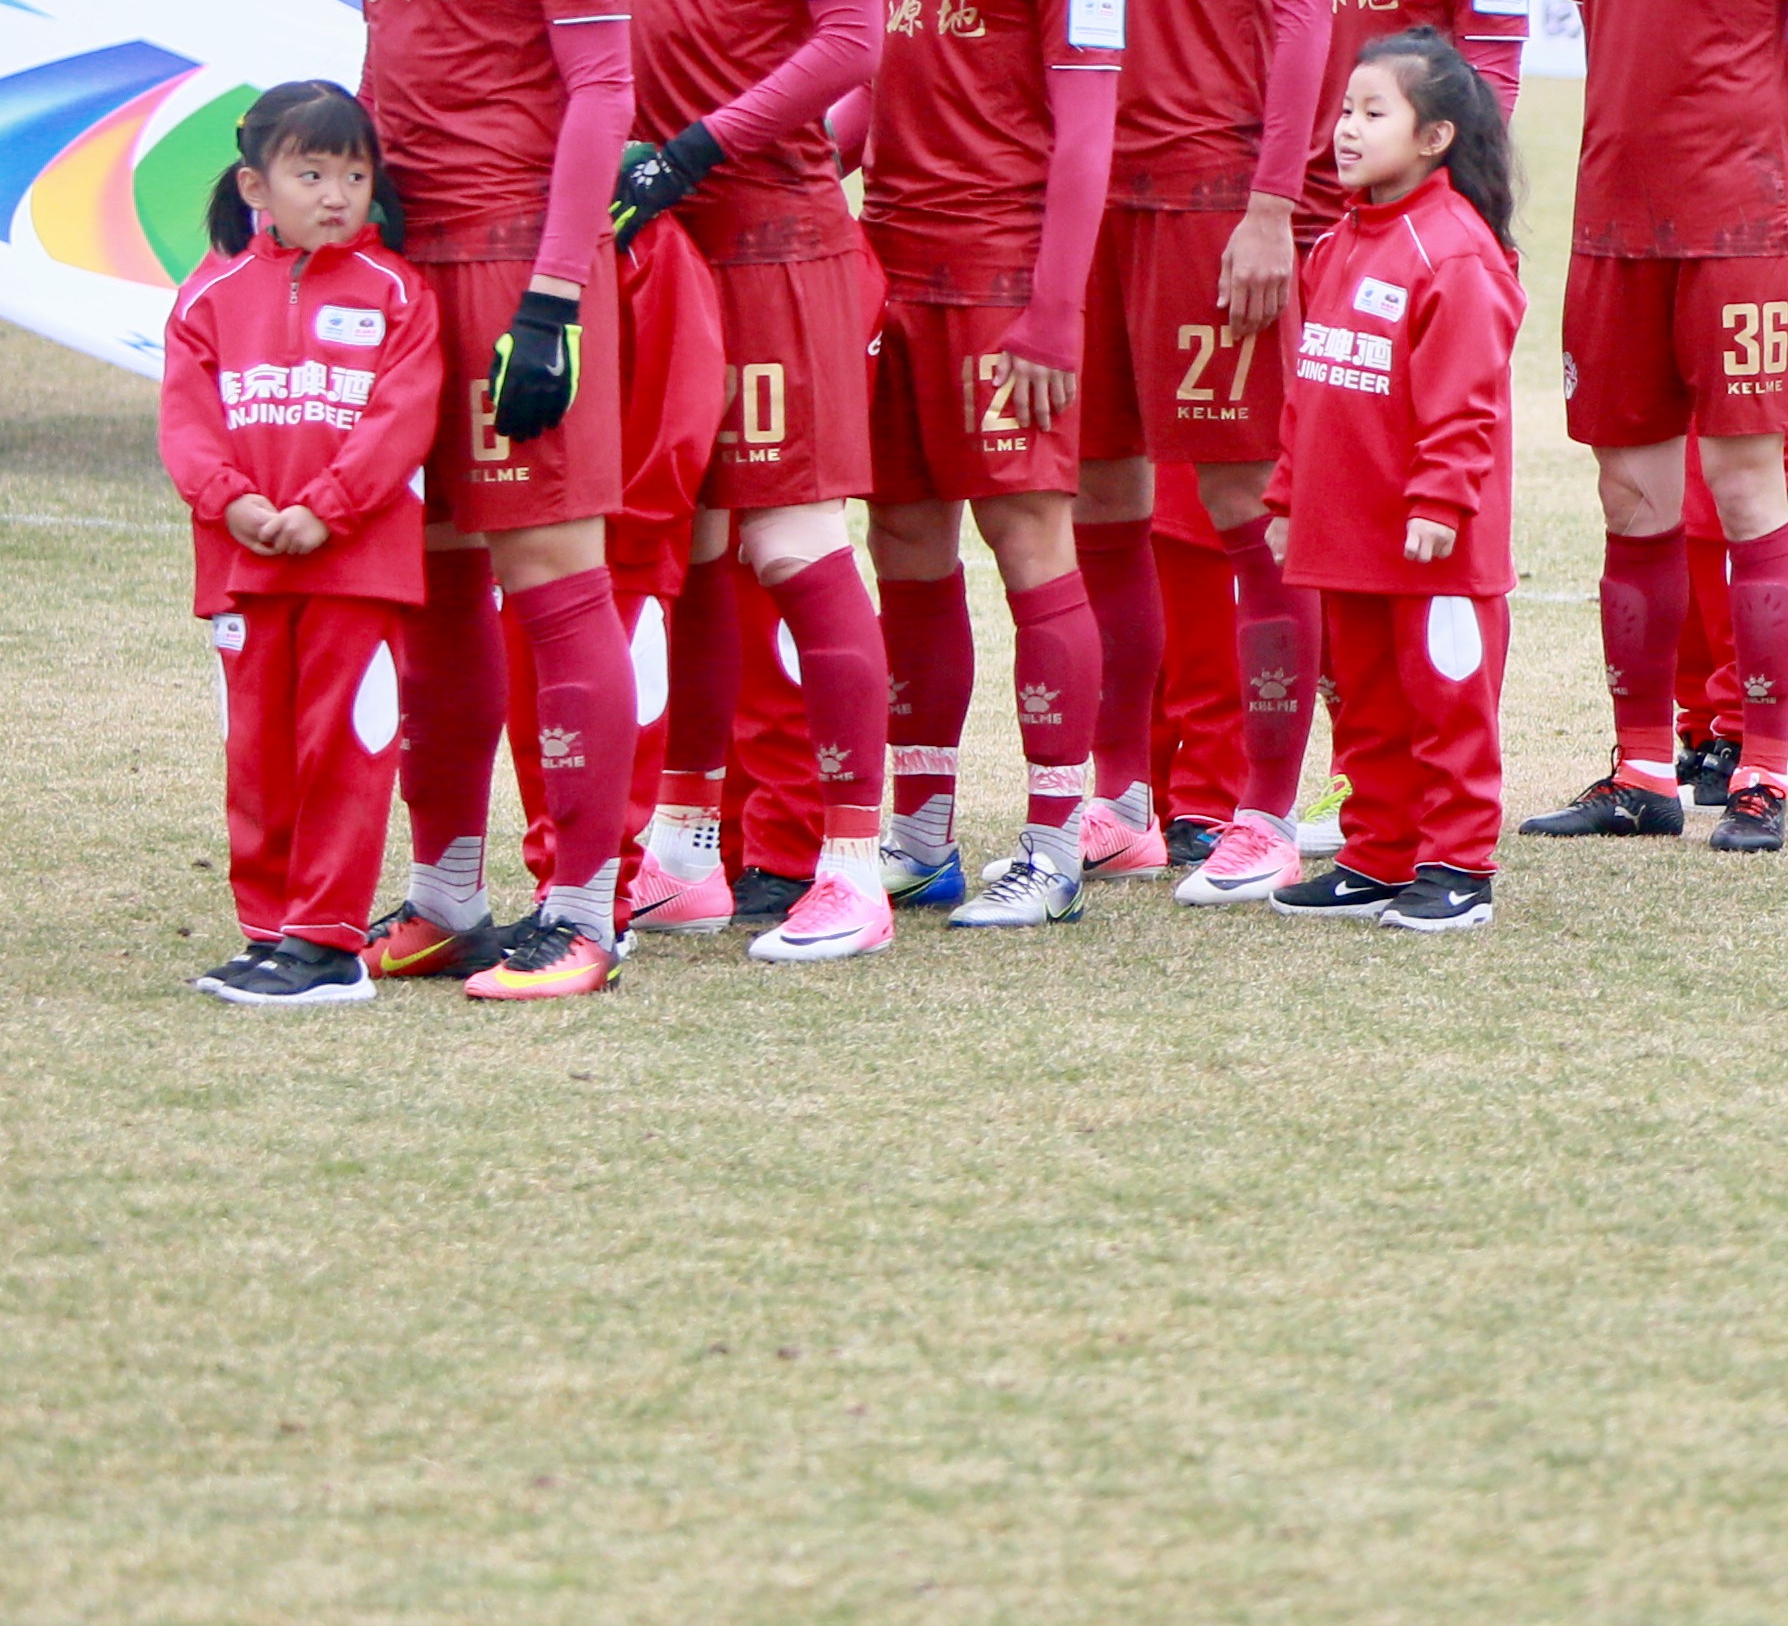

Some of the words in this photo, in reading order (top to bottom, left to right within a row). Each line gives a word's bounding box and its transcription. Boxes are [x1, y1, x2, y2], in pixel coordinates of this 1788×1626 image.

[1176, 324, 1258, 402] 27
[1328, 365, 1391, 396] BEER
[1727, 379, 1783, 395] KELME
[1177, 405, 1249, 421] KELME
